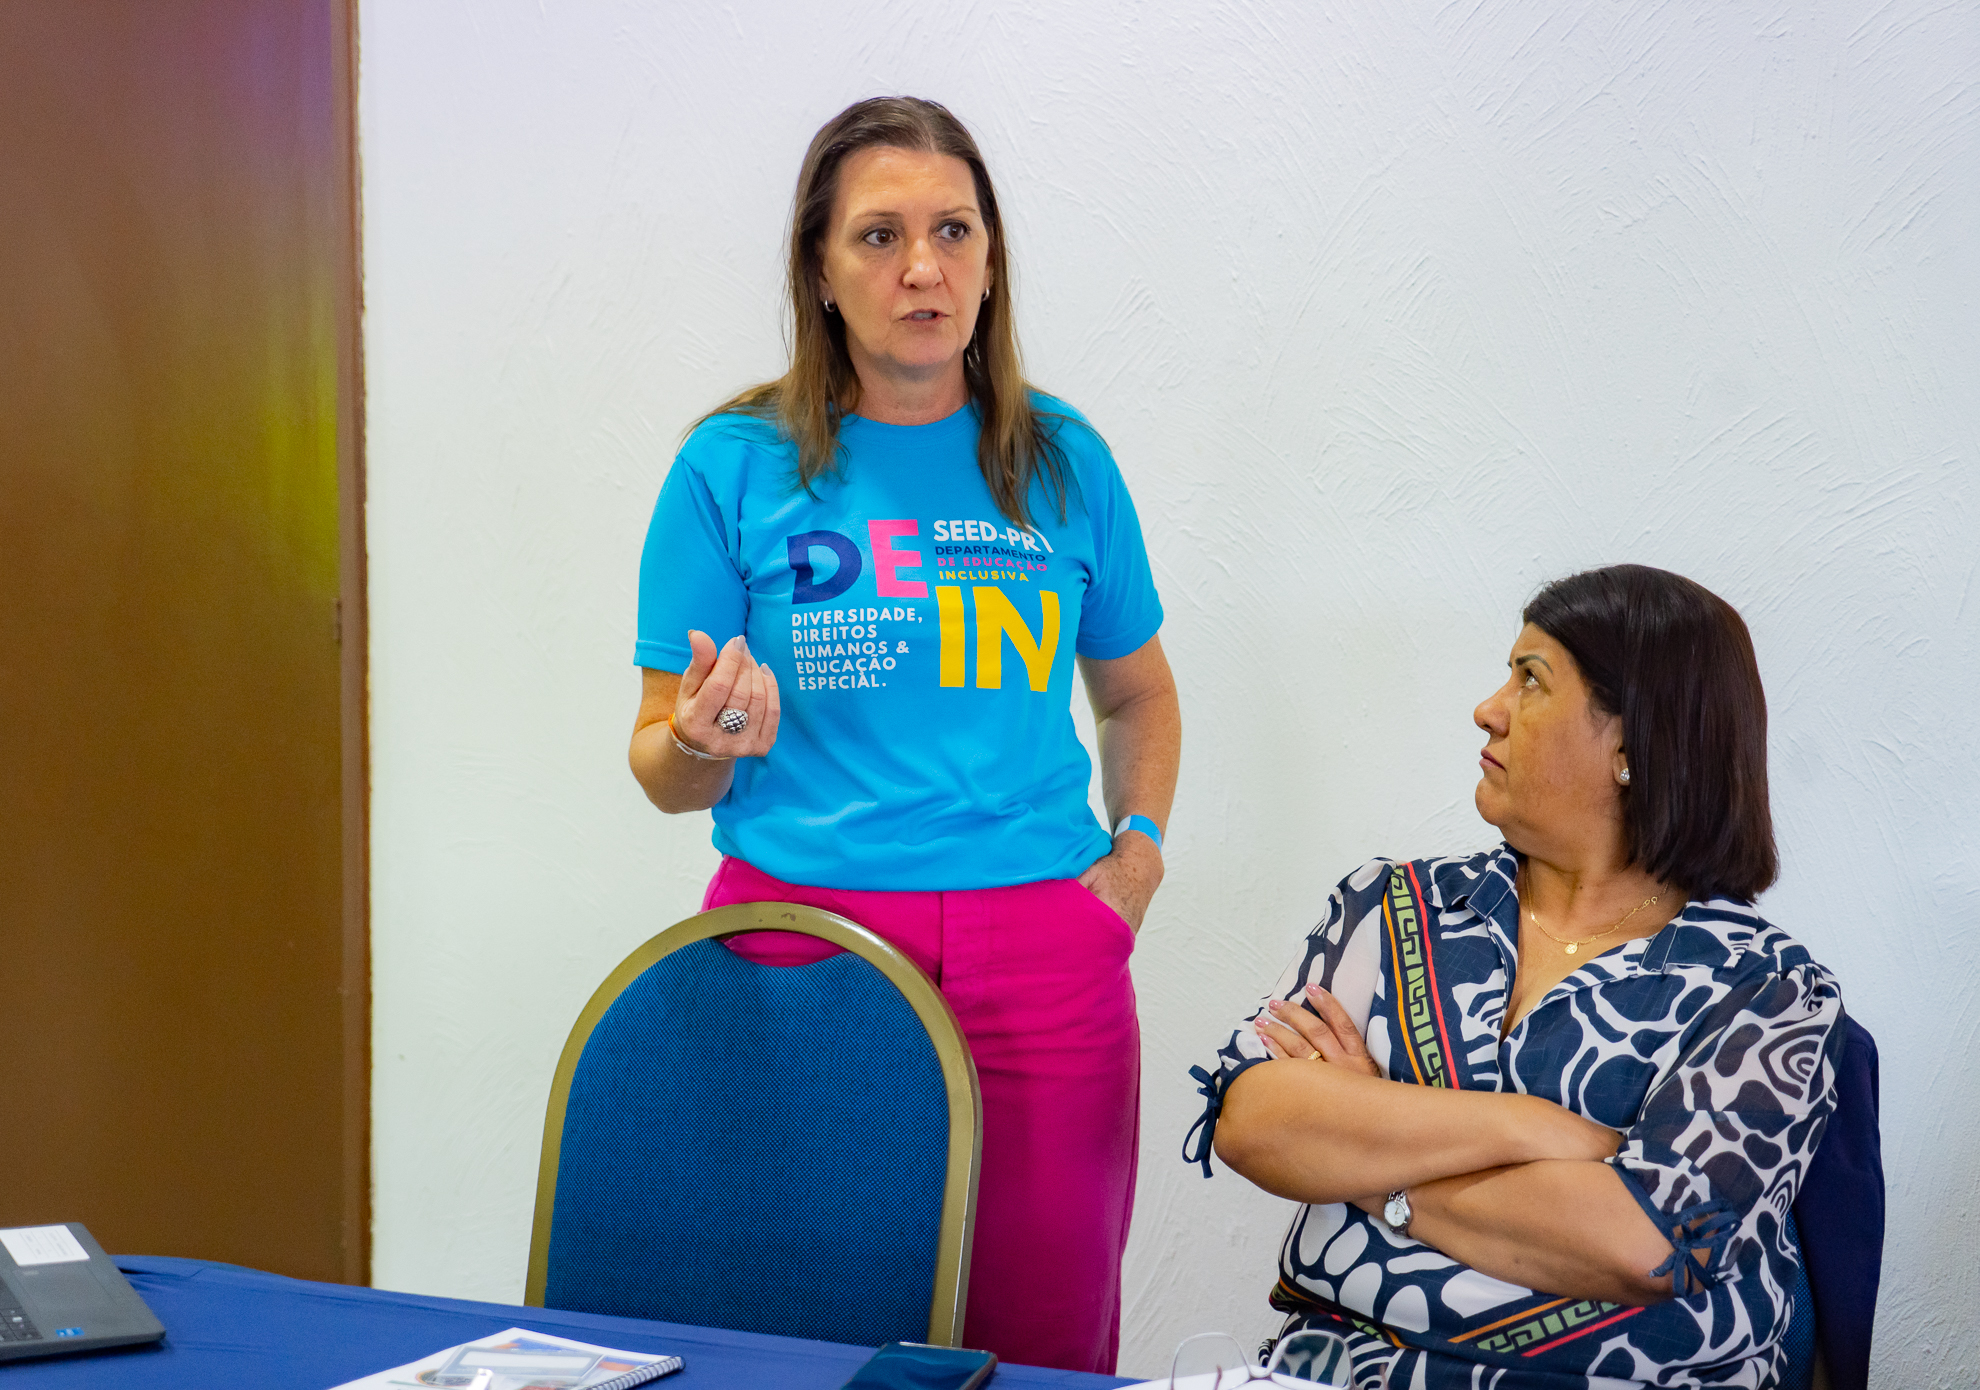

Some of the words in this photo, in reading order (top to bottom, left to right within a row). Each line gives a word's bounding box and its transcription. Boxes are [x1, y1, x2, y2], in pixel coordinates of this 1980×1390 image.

[787, 519, 929, 605] DE
[935, 546, 1045, 562] DEPARTAMENTO
[937, 557, 955, 566] DE
[963, 557, 1047, 571] EDUCAÇÃO
[939, 570, 1029, 582] INCLUSIVA
[791, 607, 923, 627] DIVERSIDADE,
[792, 624, 877, 643] DIREITOS
[936, 585, 1060, 692] IN
[793, 640, 888, 659] HUMANOS
[896, 640, 910, 654] &
[796, 653, 897, 675] EDUCAÇÃO
[798, 674, 887, 690] ESPECIAL.
